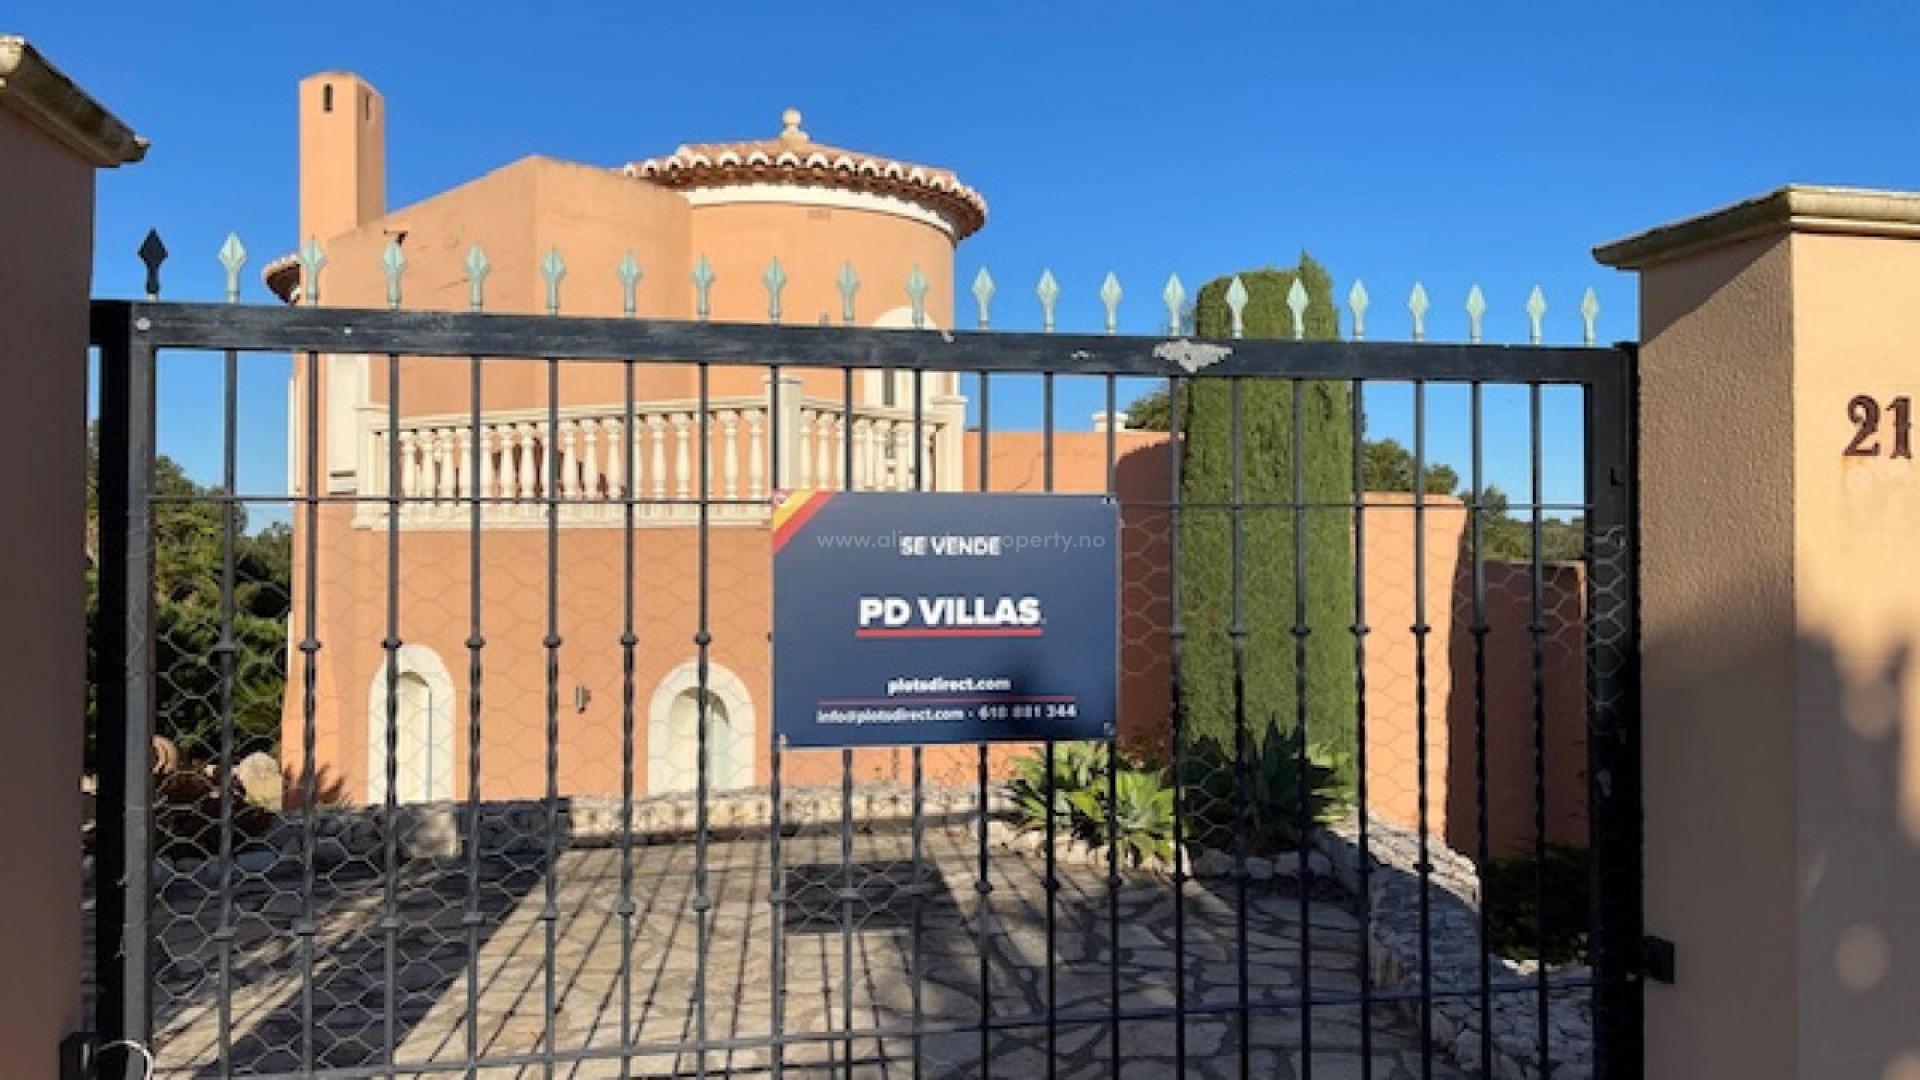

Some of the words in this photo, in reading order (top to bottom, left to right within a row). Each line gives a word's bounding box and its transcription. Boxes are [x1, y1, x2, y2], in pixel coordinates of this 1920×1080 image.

[1841, 394, 1911, 459] 21
[900, 535, 925, 555] SE
[930, 535, 1000, 555] VENDE
[859, 596, 910, 625] PD
[917, 596, 1041, 625] VILLAS
[887, 677, 1011, 696] plotsdirect.com
